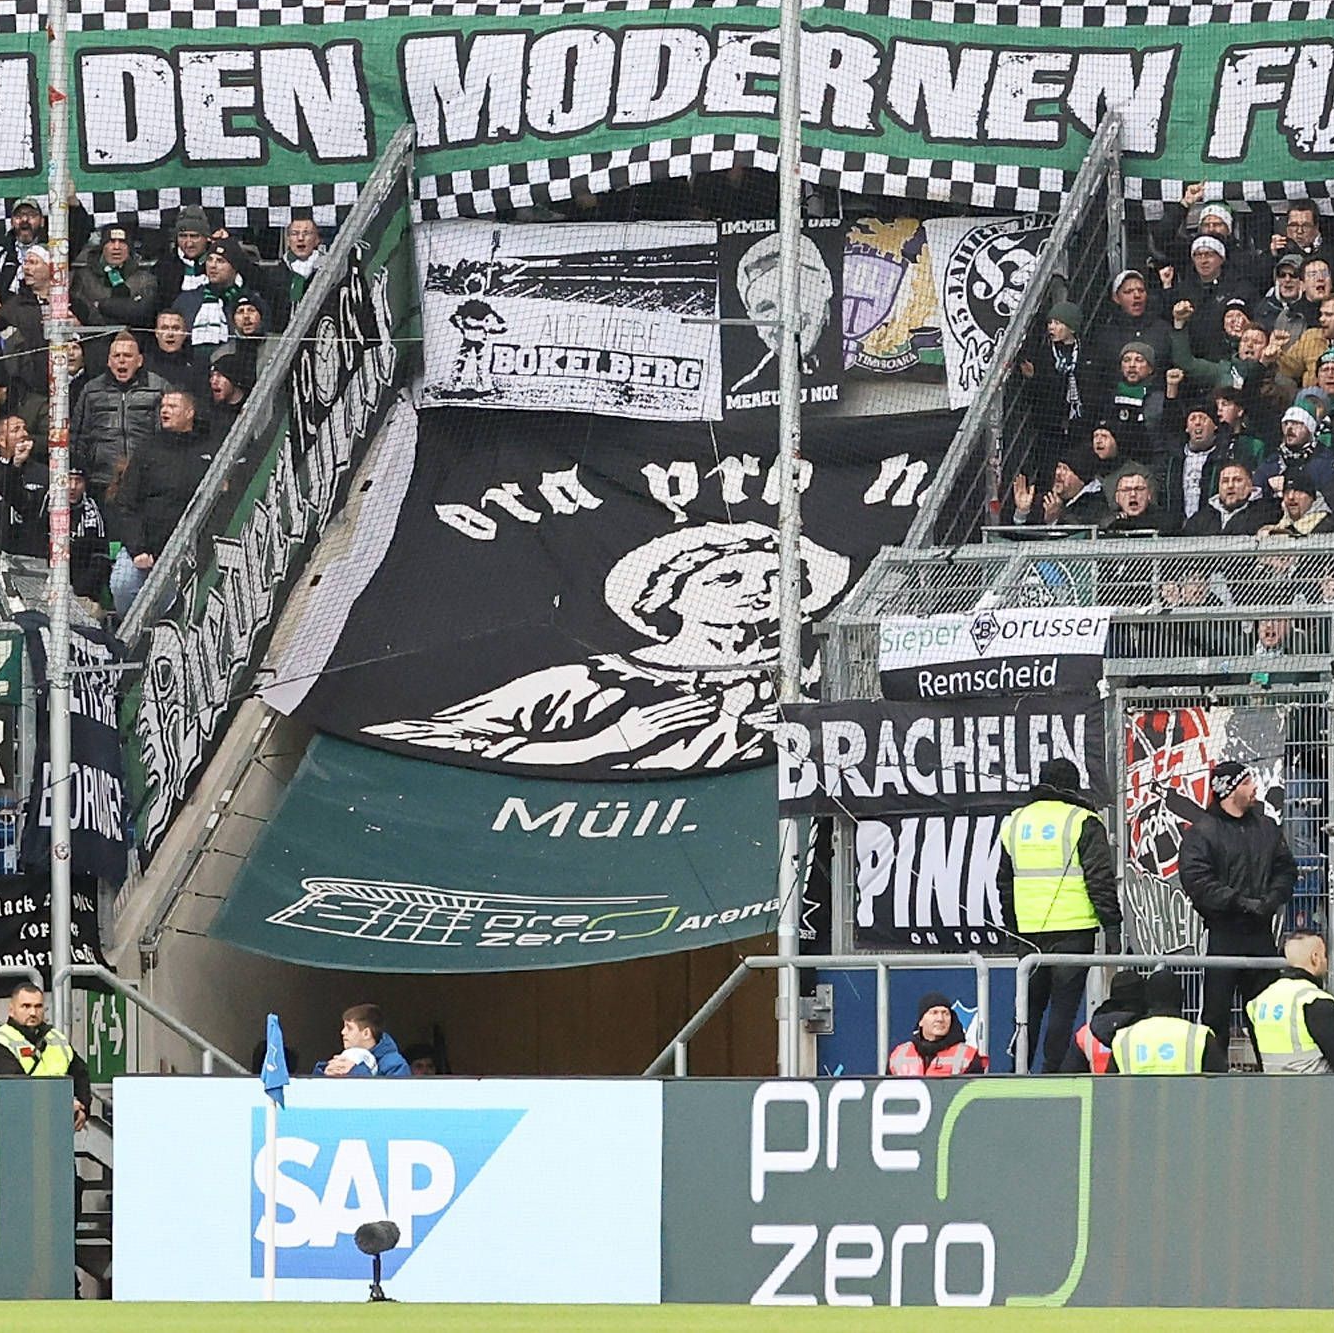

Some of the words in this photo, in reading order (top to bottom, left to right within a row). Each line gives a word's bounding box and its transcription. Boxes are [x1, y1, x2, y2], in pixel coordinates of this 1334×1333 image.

[81, 42, 372, 168] DEN
[400, 27, 1171, 161] MODERNEN
[880, 623, 963, 656] Sieper
[918, 657, 1058, 698] Remscheid
[491, 796, 699, 839] Müll.
[476, 929, 616, 947] zero
[484, 913, 589, 930] pre
[910, 932, 939, 946] ON
[955, 931, 1000, 946] TOU
[750, 1078, 933, 1204] pre
[253, 1135, 456, 1249] SAP
[749, 1222, 997, 1308] zero
